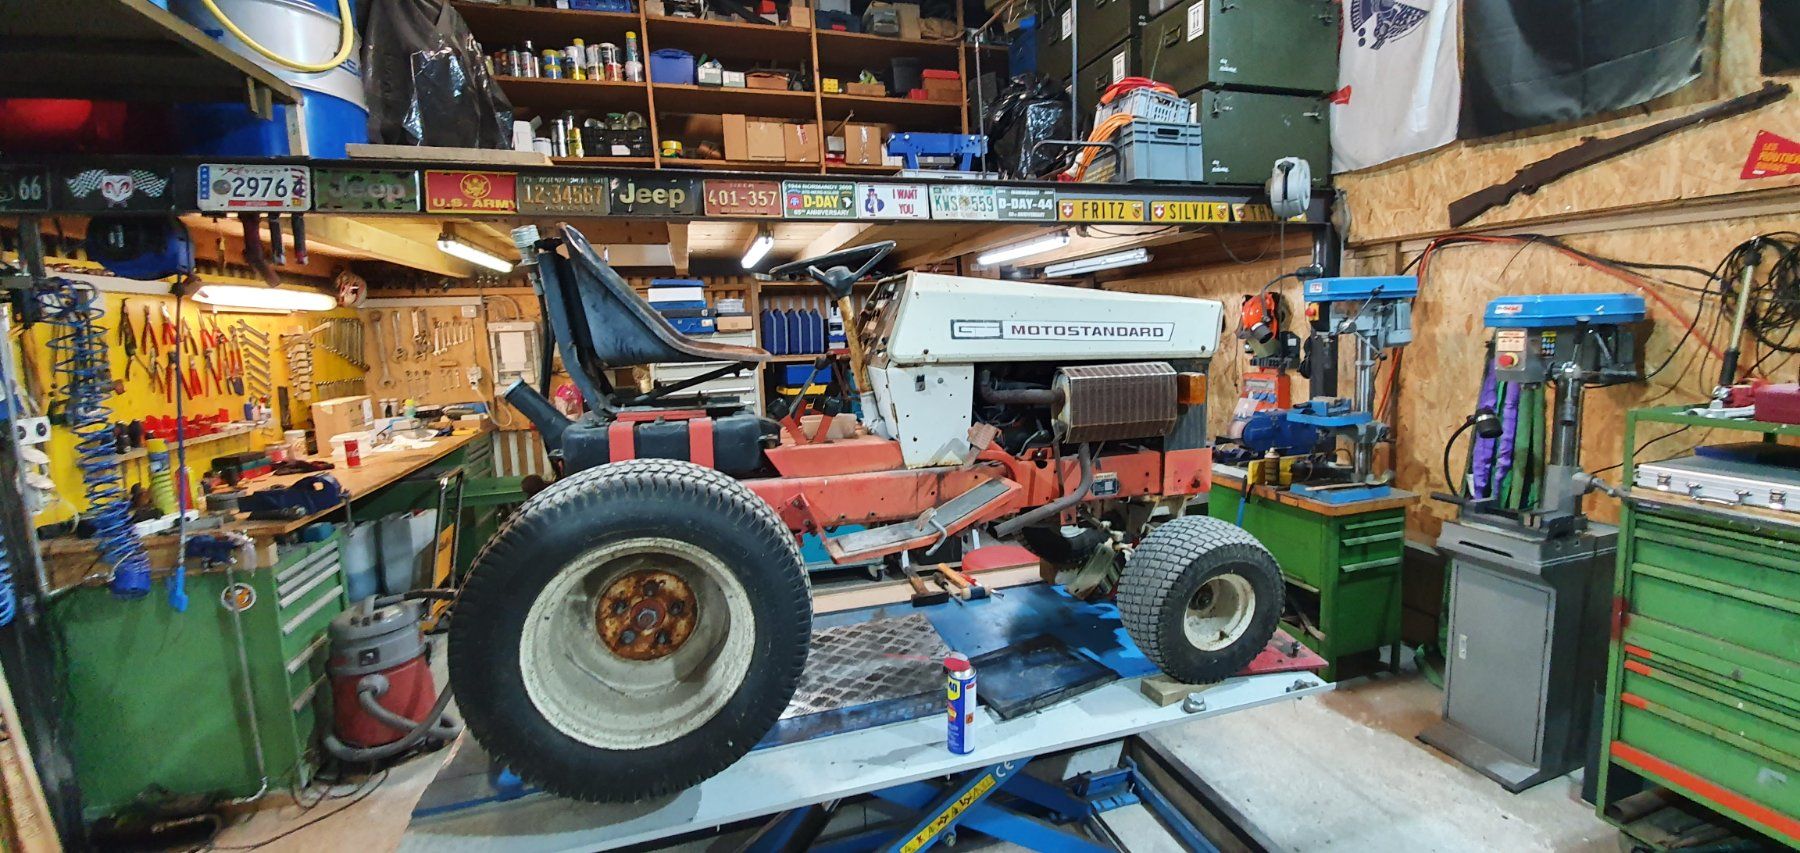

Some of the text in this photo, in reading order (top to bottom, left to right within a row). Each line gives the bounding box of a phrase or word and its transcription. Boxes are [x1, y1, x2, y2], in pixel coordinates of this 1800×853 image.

[19, 175, 42, 200] 66
[232, 177, 288, 198] 2976
[328, 178, 406, 203] Jeep
[619, 182, 686, 208] Jeep
[897, 188, 918, 200] WANT
[432, 198, 468, 208] U.S.
[708, 189, 778, 207] 401-357
[803, 194, 839, 209] D-DAY
[971, 195, 994, 212] 559
[998, 197, 1054, 210] D-DAY-44
[898, 203, 915, 215] YOU
[1081, 201, 1126, 220] FRITZ
[1169, 203, 1214, 220] SILVIA
[1011, 324, 1164, 338] MOTOSTANDARD
